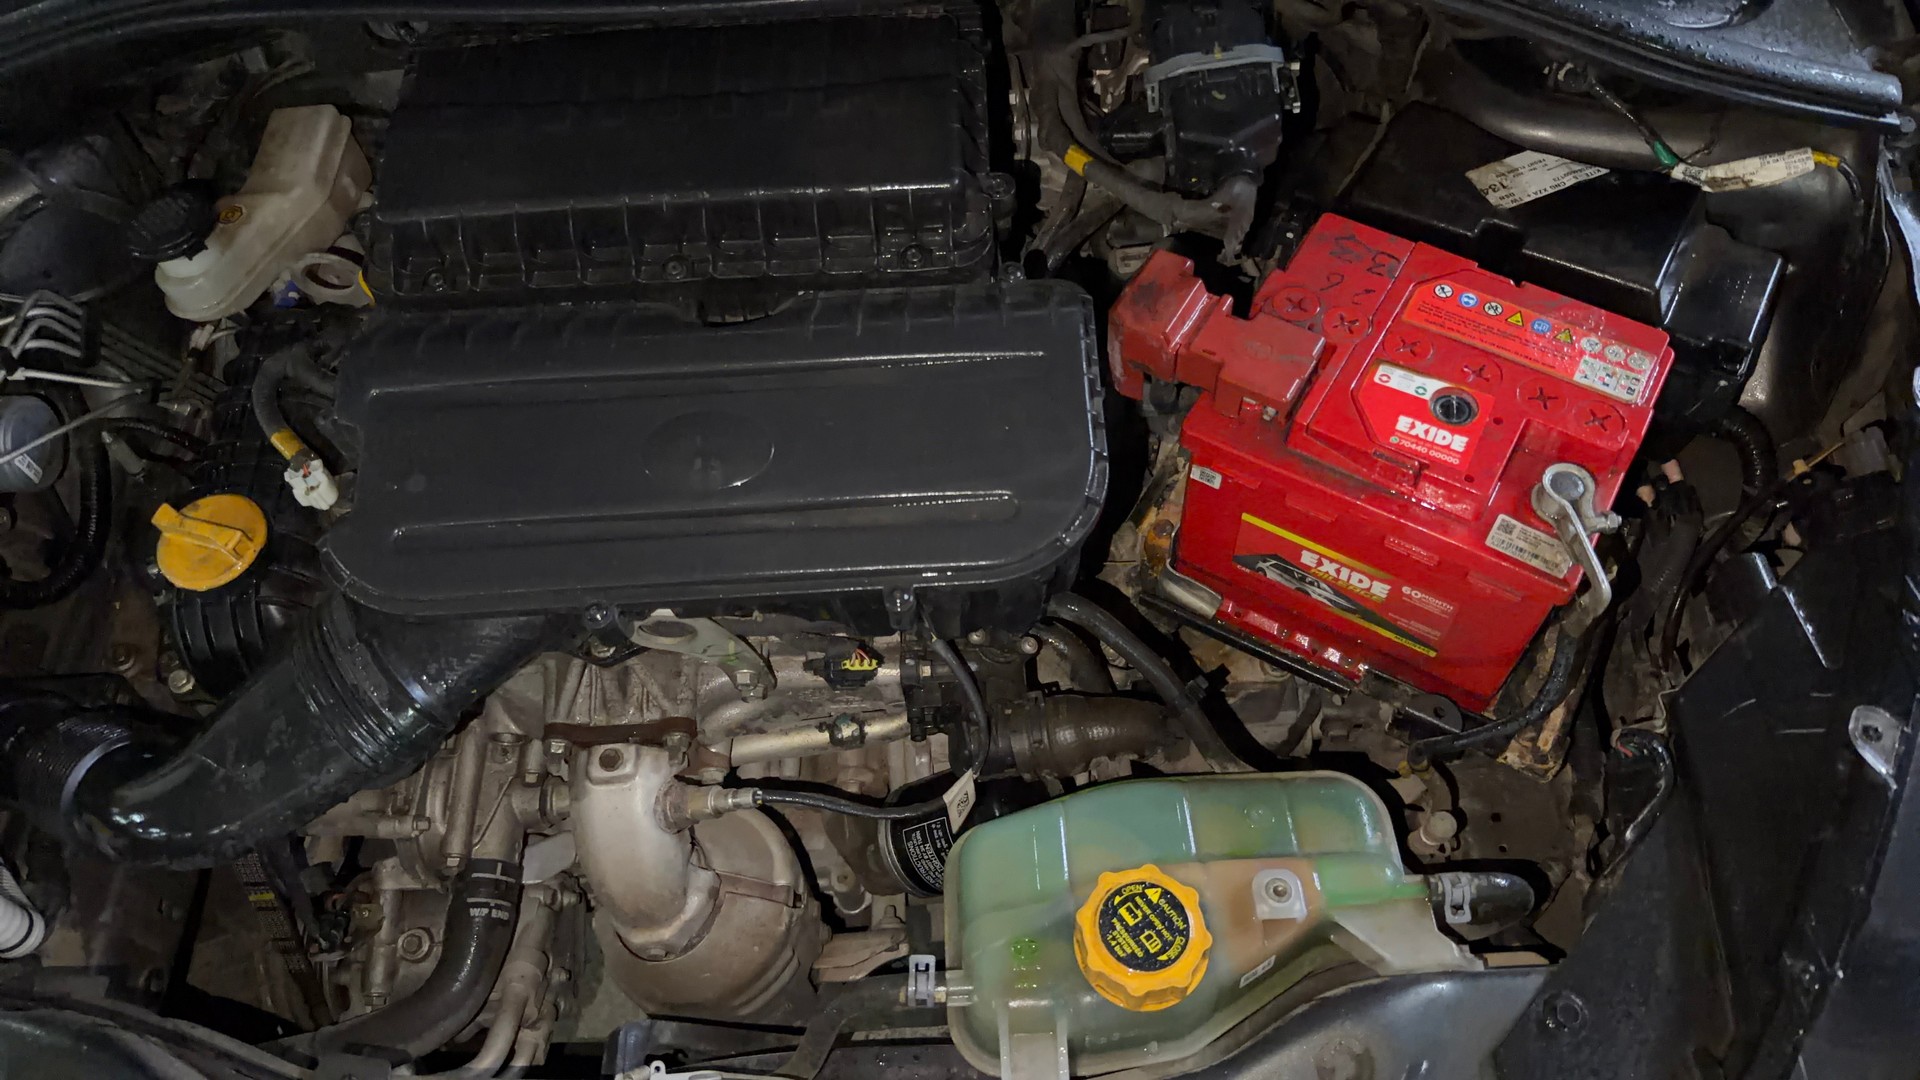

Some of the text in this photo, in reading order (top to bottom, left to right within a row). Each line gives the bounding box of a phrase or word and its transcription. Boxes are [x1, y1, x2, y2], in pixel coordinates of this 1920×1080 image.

[1549, 180, 1566, 190] CNG
[1395, 415, 1469, 452] EXIDE
[1398, 438, 1460, 465] 70440 00000
[1299, 549, 1391, 598] EXIDE
[1421, 593, 1453, 610] MONTH
[906, 840, 934, 883] INSTRUCTIONS
[924, 842, 942, 872] TIGHTEN
[1121, 885, 1143, 893] OPEN
[491, 909, 509, 920] END
[1133, 895, 1173, 941] NEVER OPEN HOT
[1158, 898, 1186, 930] CAUTION
[1105, 933, 1127, 958] 1.4 bar
[1110, 929, 1133, 954] SYSTEM
[1167, 936, 1184, 960] CLOSE
